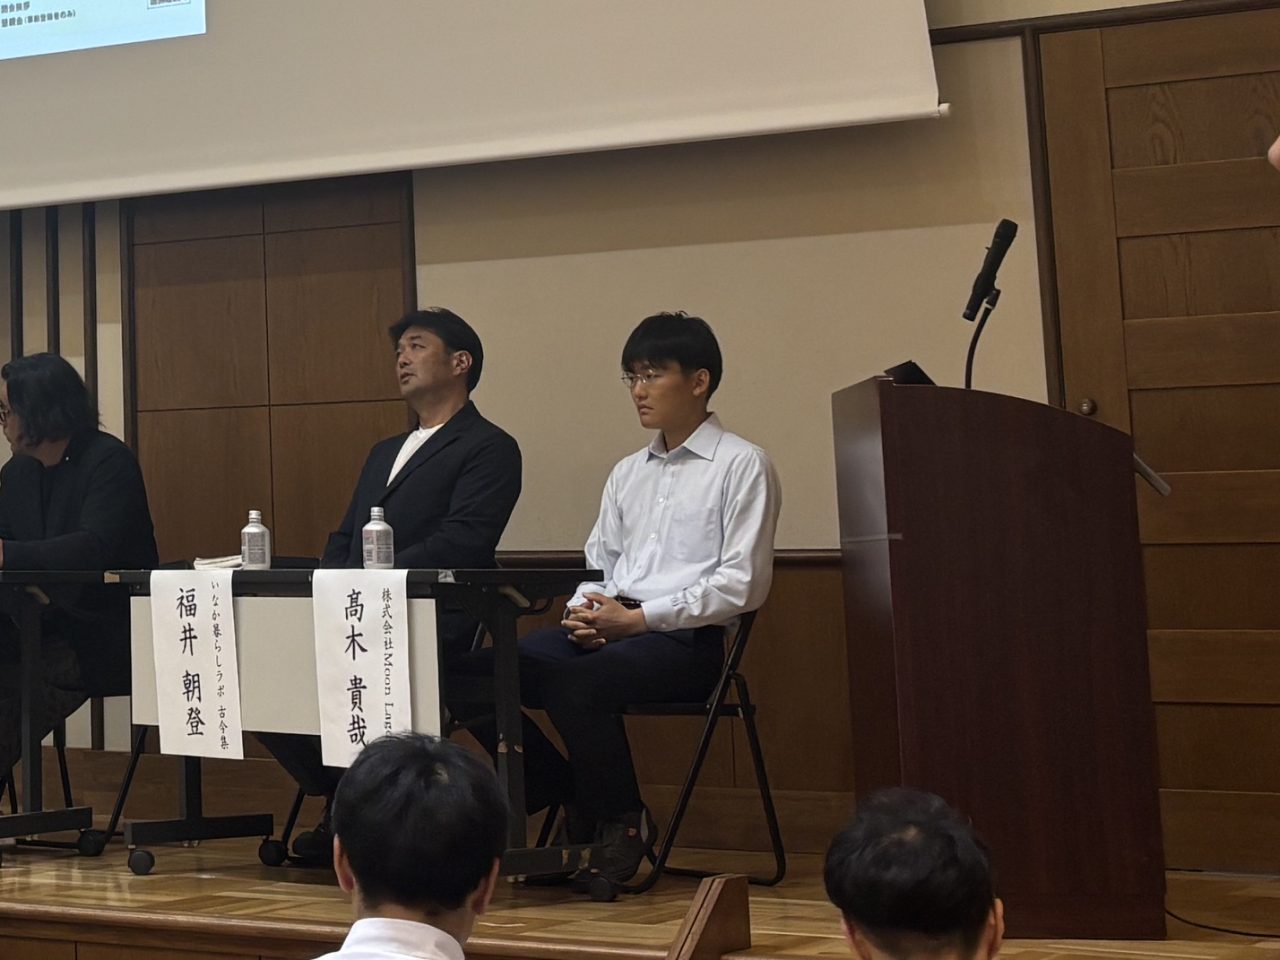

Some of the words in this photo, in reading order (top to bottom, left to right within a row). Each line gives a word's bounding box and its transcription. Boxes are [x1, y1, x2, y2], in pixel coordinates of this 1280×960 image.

[175, 587, 198, 657] 福井
[181, 669, 206, 737] 朝登
[346, 674, 369, 748] 貴哉
